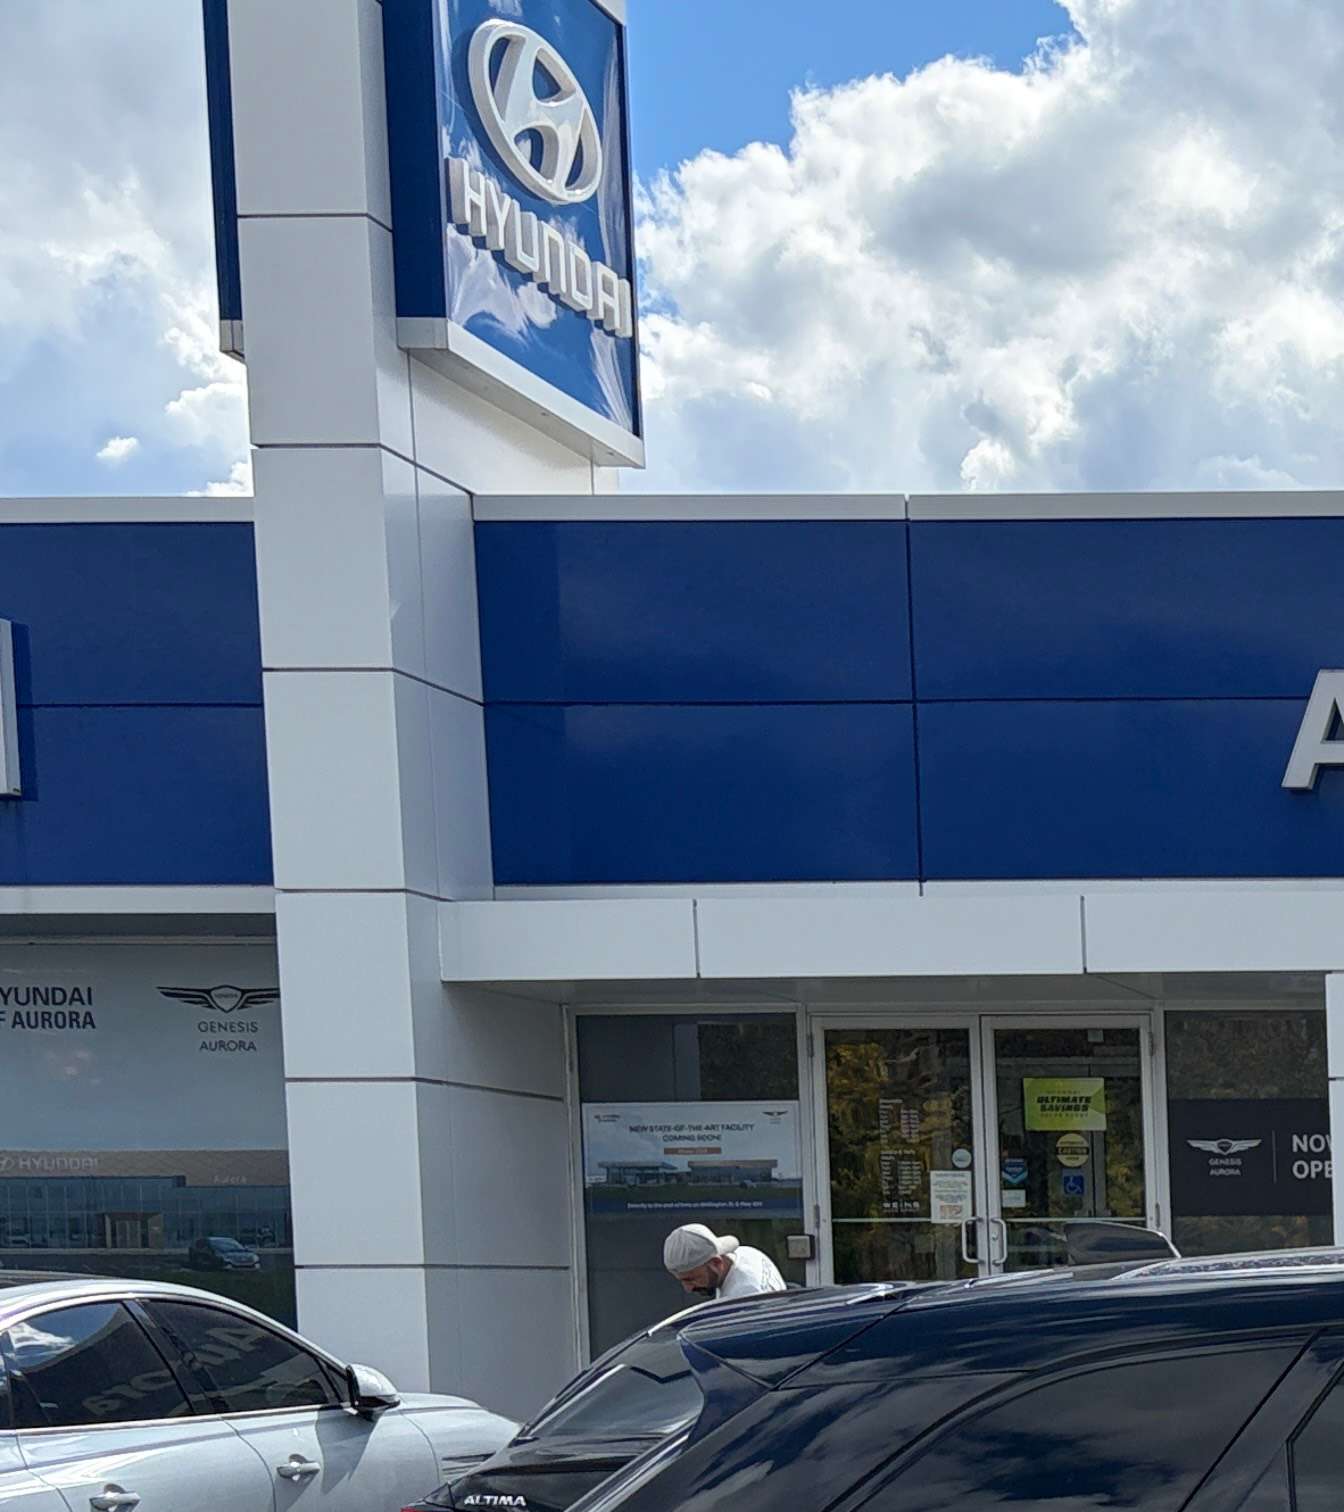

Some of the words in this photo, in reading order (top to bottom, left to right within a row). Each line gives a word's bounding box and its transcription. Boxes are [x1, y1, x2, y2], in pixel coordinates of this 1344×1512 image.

[445, 157, 633, 338] HYUNDAI
[0, 986, 94, 1006] YUNDAI
[11, 1010, 96, 1030] AURORA
[197, 1021, 259, 1033] GENESIS
[199, 1040, 257, 1051] AURORA
[18, 1157, 98, 1171] HYUNDAI
[1208, 1158, 1242, 1166] GENESIS
[1292, 1160, 1332, 1179] OPE
[463, 1494, 527, 1507] ALTIMA
